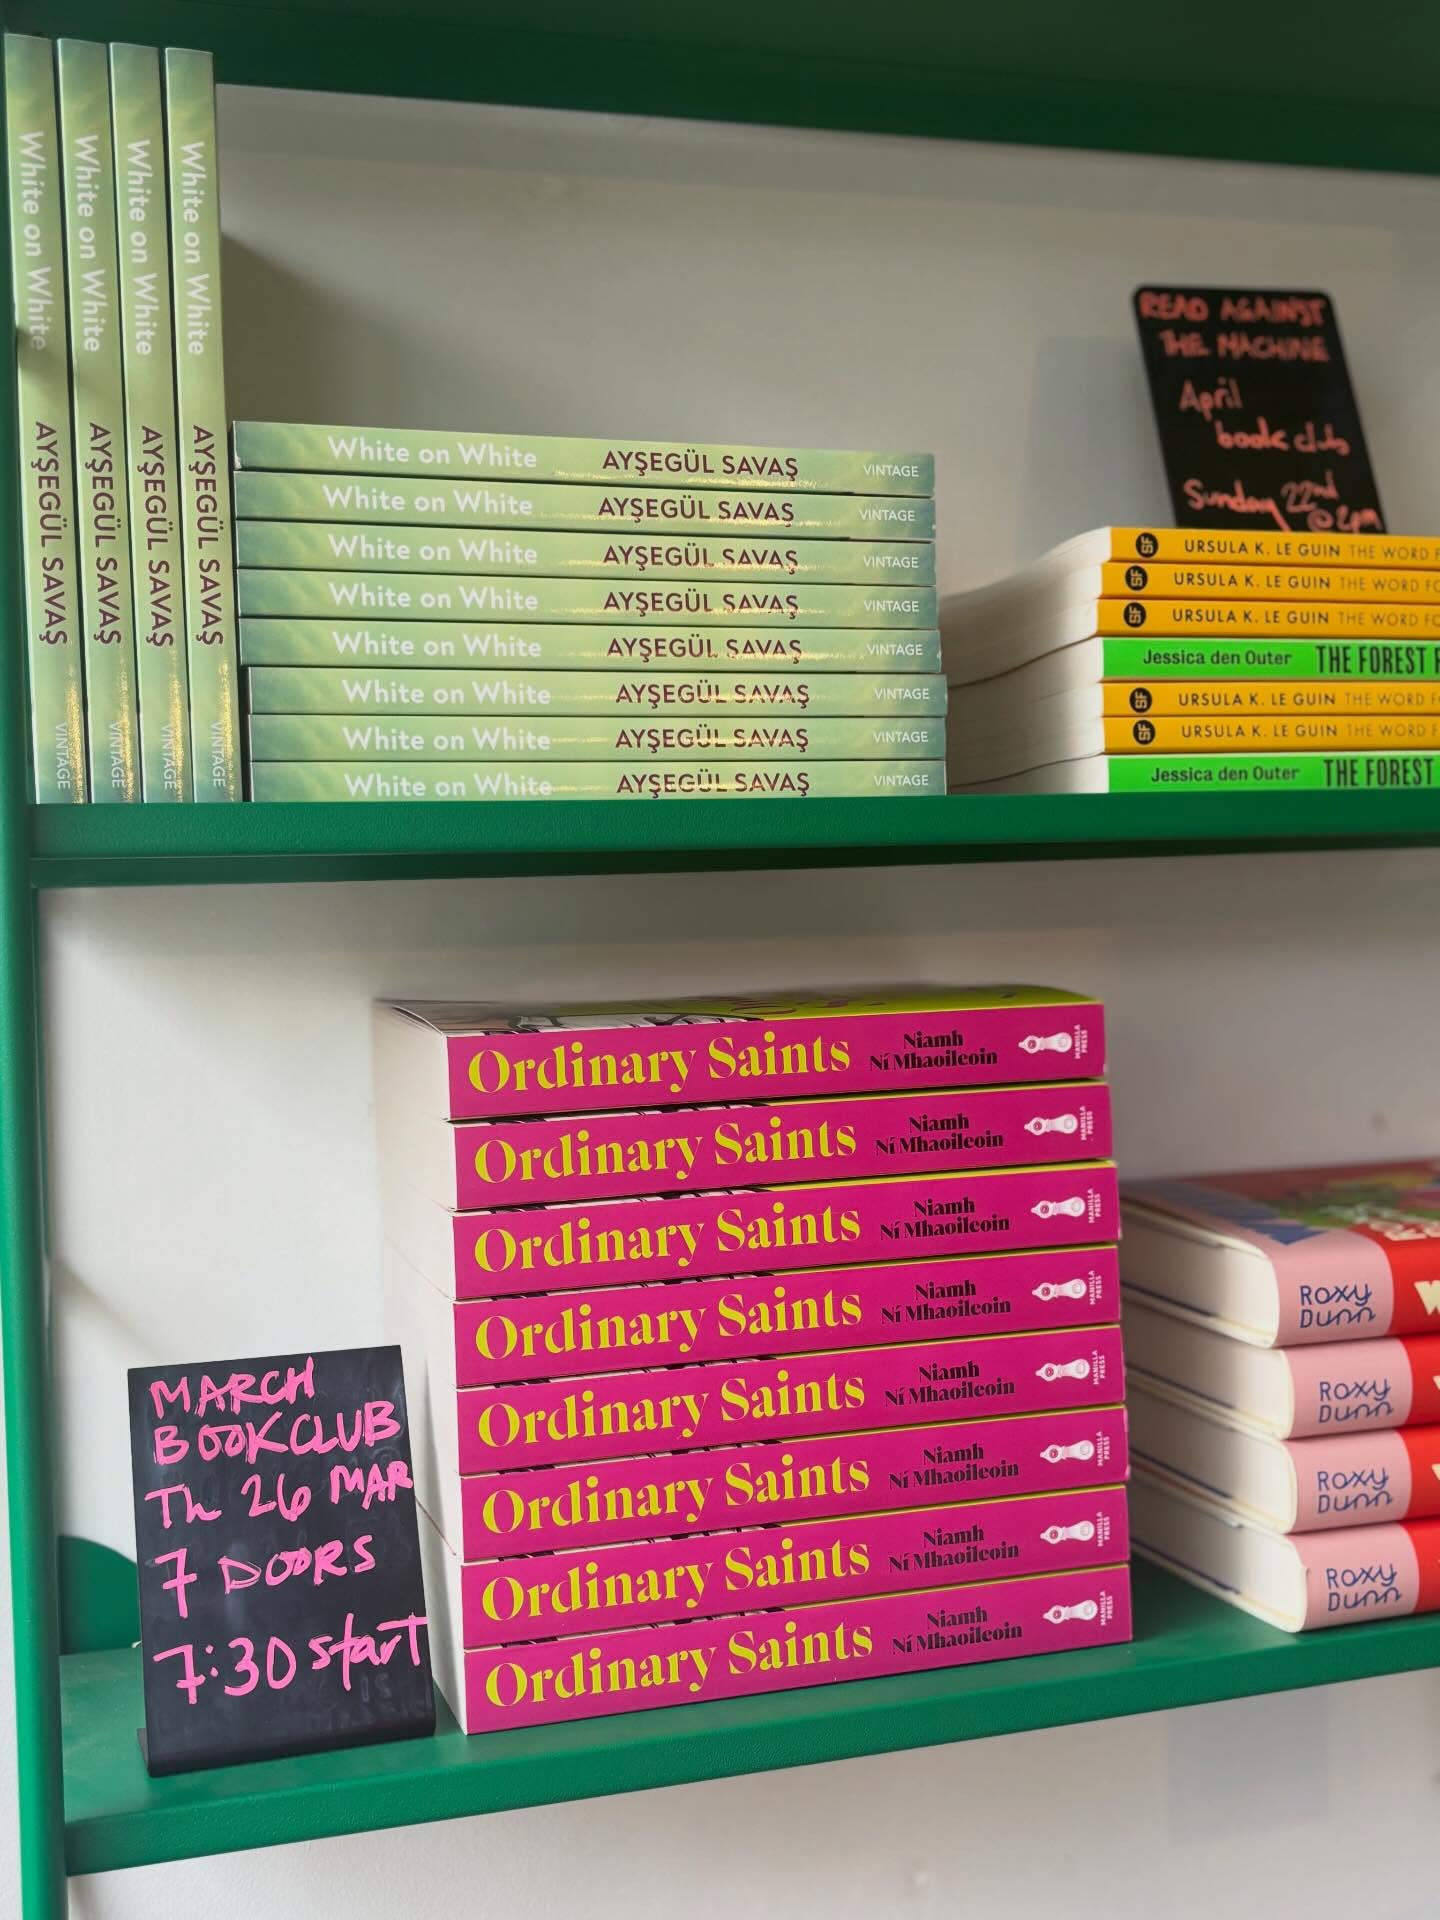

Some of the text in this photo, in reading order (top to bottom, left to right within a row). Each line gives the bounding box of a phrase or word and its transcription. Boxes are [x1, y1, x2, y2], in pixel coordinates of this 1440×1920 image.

[1138, 291, 1325, 327] READ AGAINST
[1159, 329, 1329, 362] THE MACHINE
[20, 131, 68, 645] White on White AYŞEGÜL SAVAŞ
[75, 135, 122, 645] White on White AYŞEGÜL SAVAŞ
[127, 140, 174, 646] White on White AYŞEGÜL SAVAŞ
[180, 141, 225, 645] White on White AYŞEGÜL SAVAŞ
[1179, 377, 1242, 421] April
[1214, 416, 1349, 456] book club
[327, 436, 919, 481] White on White AYŞEGÜL SAVAŞ VINTAGE
[322, 484, 916, 527] White on White AYŞEGÜL SAVAŞ VINTAGE
[1183, 469, 1339, 532] Sunday 22nd
[328, 534, 919, 569] White on White VINTAGE
[1185, 540, 1429, 560] URSULA K. LE GUIN THE WORD
[328, 583, 919, 617] White on White AYŞEGÜL VINTAGE
[1174, 573, 1419, 592] URSULA K. LE GUIN THE WORD
[1173, 609, 1328, 624] URSULA K. LE GUIN
[332, 631, 923, 658] White on White VINTAGE
[1143, 646, 1427, 674] Jessica den Outer THE FOREST
[342, 679, 930, 709] White on White AYŞEGÜL SAVAŞ VINTAGE
[1179, 693, 1335, 706] URSULA K. LE GUIN
[343, 724, 929, 754] White on White AYŞEGÜL SAVAŞ VINTAGE
[1182, 724, 1337, 738] URSULA K. LE GUIN
[344, 769, 929, 799] White on White AYŞEGÜL SAVAŞ VINTAGE
[1151, 758, 1433, 786] Jessica den Outer THE FOREST
[904, 1030, 963, 1049] Niamh
[468, 1031, 850, 1093] Ordinary Saints
[870, 1054, 889, 1072] Ní
[909, 1113, 969, 1133] Niamh
[475, 1117, 856, 1183] Ordinary Saints
[876, 1138, 894, 1156] Ní
[914, 1197, 975, 1217] Niamh
[474, 1202, 861, 1272] Ordinary Saints
[915, 1280, 976, 1301] Niamh
[475, 1286, 862, 1360] Ordinary Saints
[150, 1356, 315, 1419] MARCH
[478, 1370, 866, 1447] Ordinary Saints
[144, 1460, 414, 1529] Th 26 MAR
[482, 1454, 870, 1534] Ordinary Saints
[155, 1535, 376, 1619] 7 DOORS
[482, 1538, 870, 1622] Ordinary Saints
[153, 1636, 297, 1705] 7:30
[485, 1621, 873, 1707] Ordinary Saints
